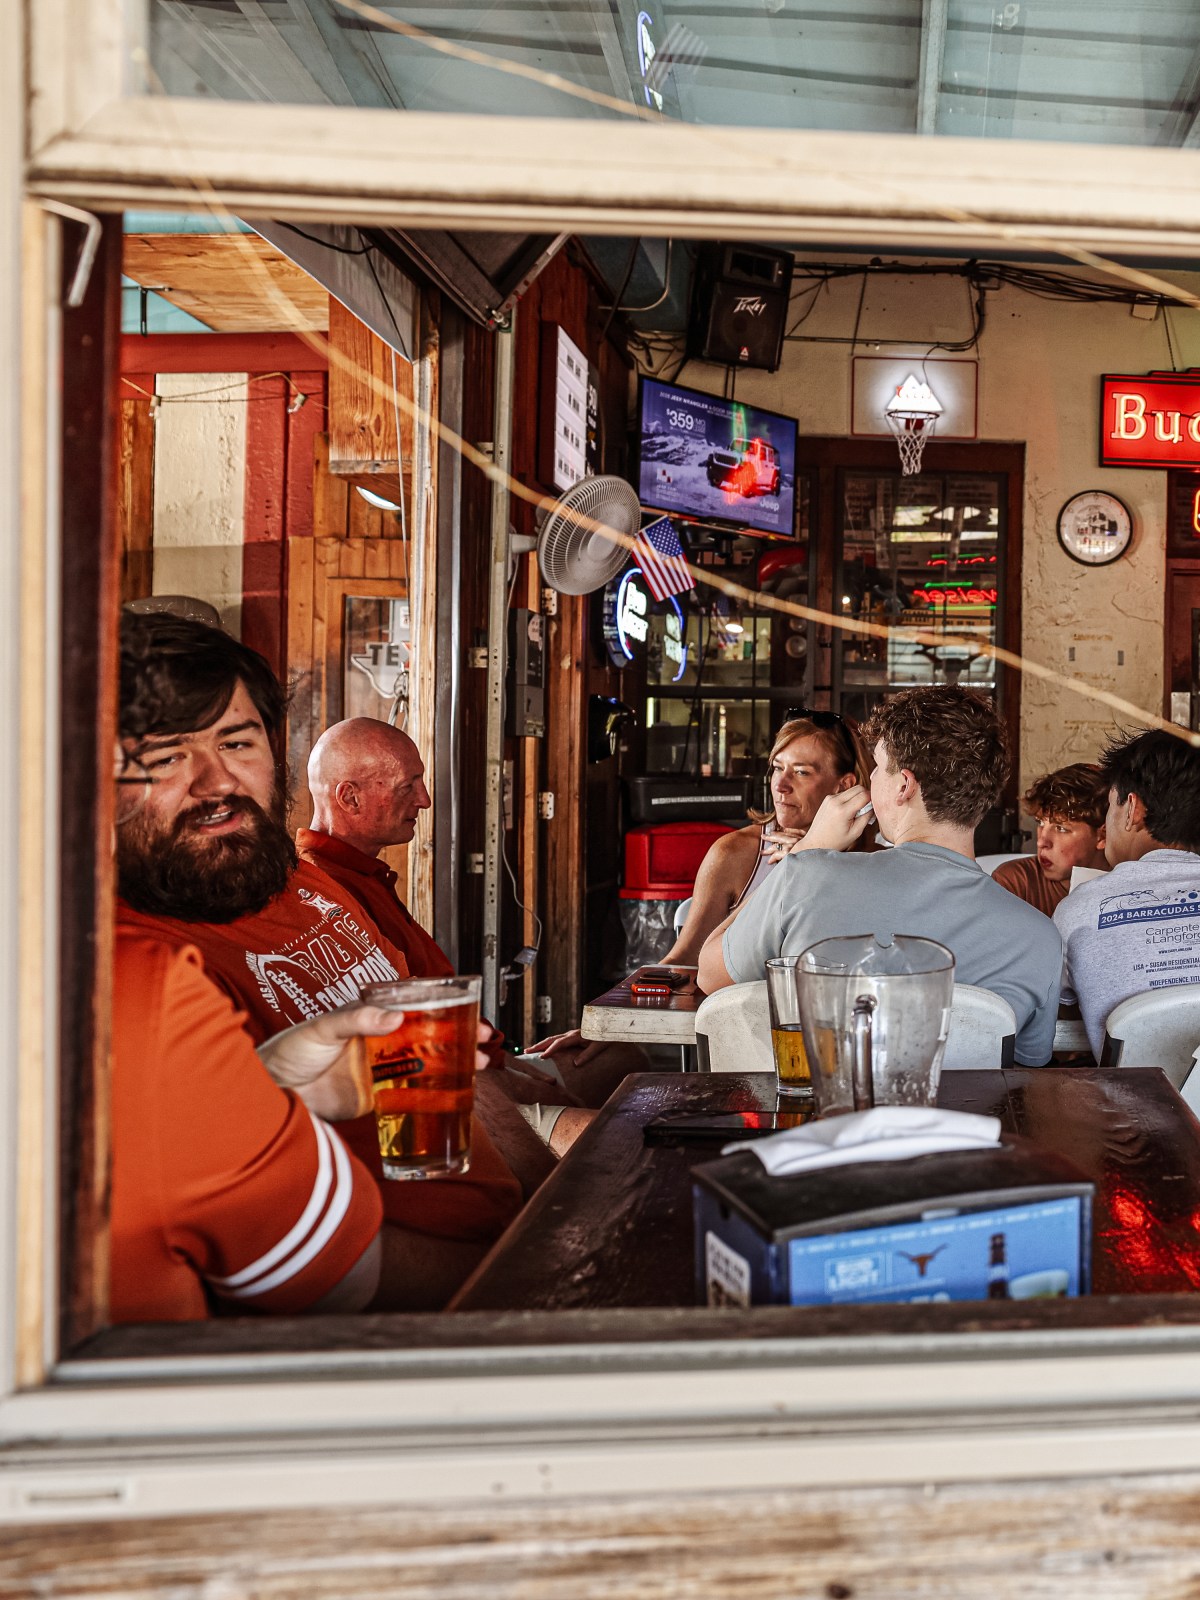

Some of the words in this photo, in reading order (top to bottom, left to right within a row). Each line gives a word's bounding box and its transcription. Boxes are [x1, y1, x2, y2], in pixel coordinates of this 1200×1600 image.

[666, 408, 694, 430] $359
[760, 498, 779, 512] Jeep
[1101, 913, 1124, 924] 2024
[1126, 905, 1195, 919] BARRACUDAS
[1133, 963, 1145, 972] LISA
[1149, 961, 1167, 969] SUSAN
[1167, 957, 1200, 967] RESIDENTIAL
[1149, 976, 1189, 987] INDEPENDENCE
